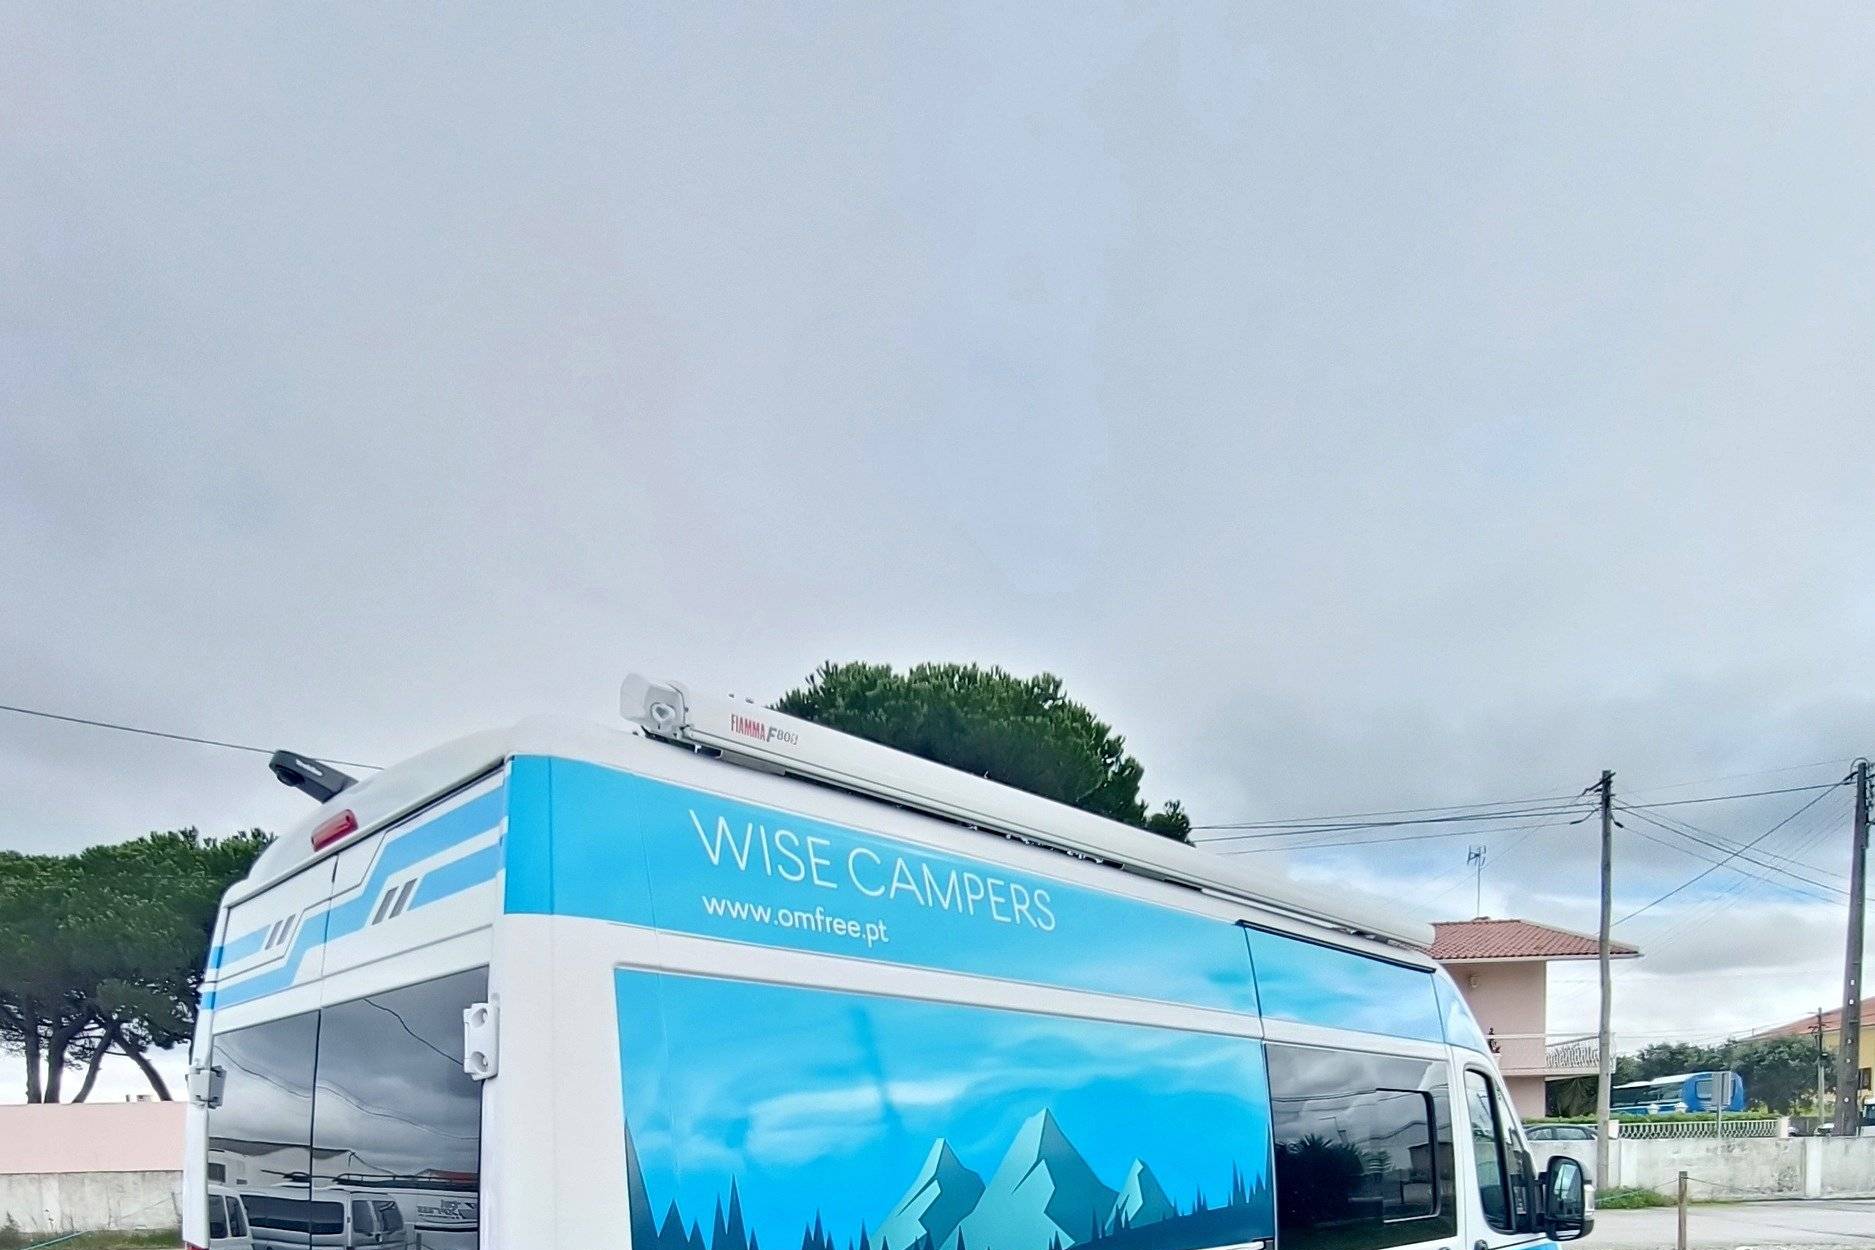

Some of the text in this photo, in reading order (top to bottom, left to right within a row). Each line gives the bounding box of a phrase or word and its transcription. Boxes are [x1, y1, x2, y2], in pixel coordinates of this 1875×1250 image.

[731, 713, 765, 742] FIAMMA
[690, 808, 1056, 932] WISE CAMPERS
[703, 895, 889, 948] www.omfree.pt
